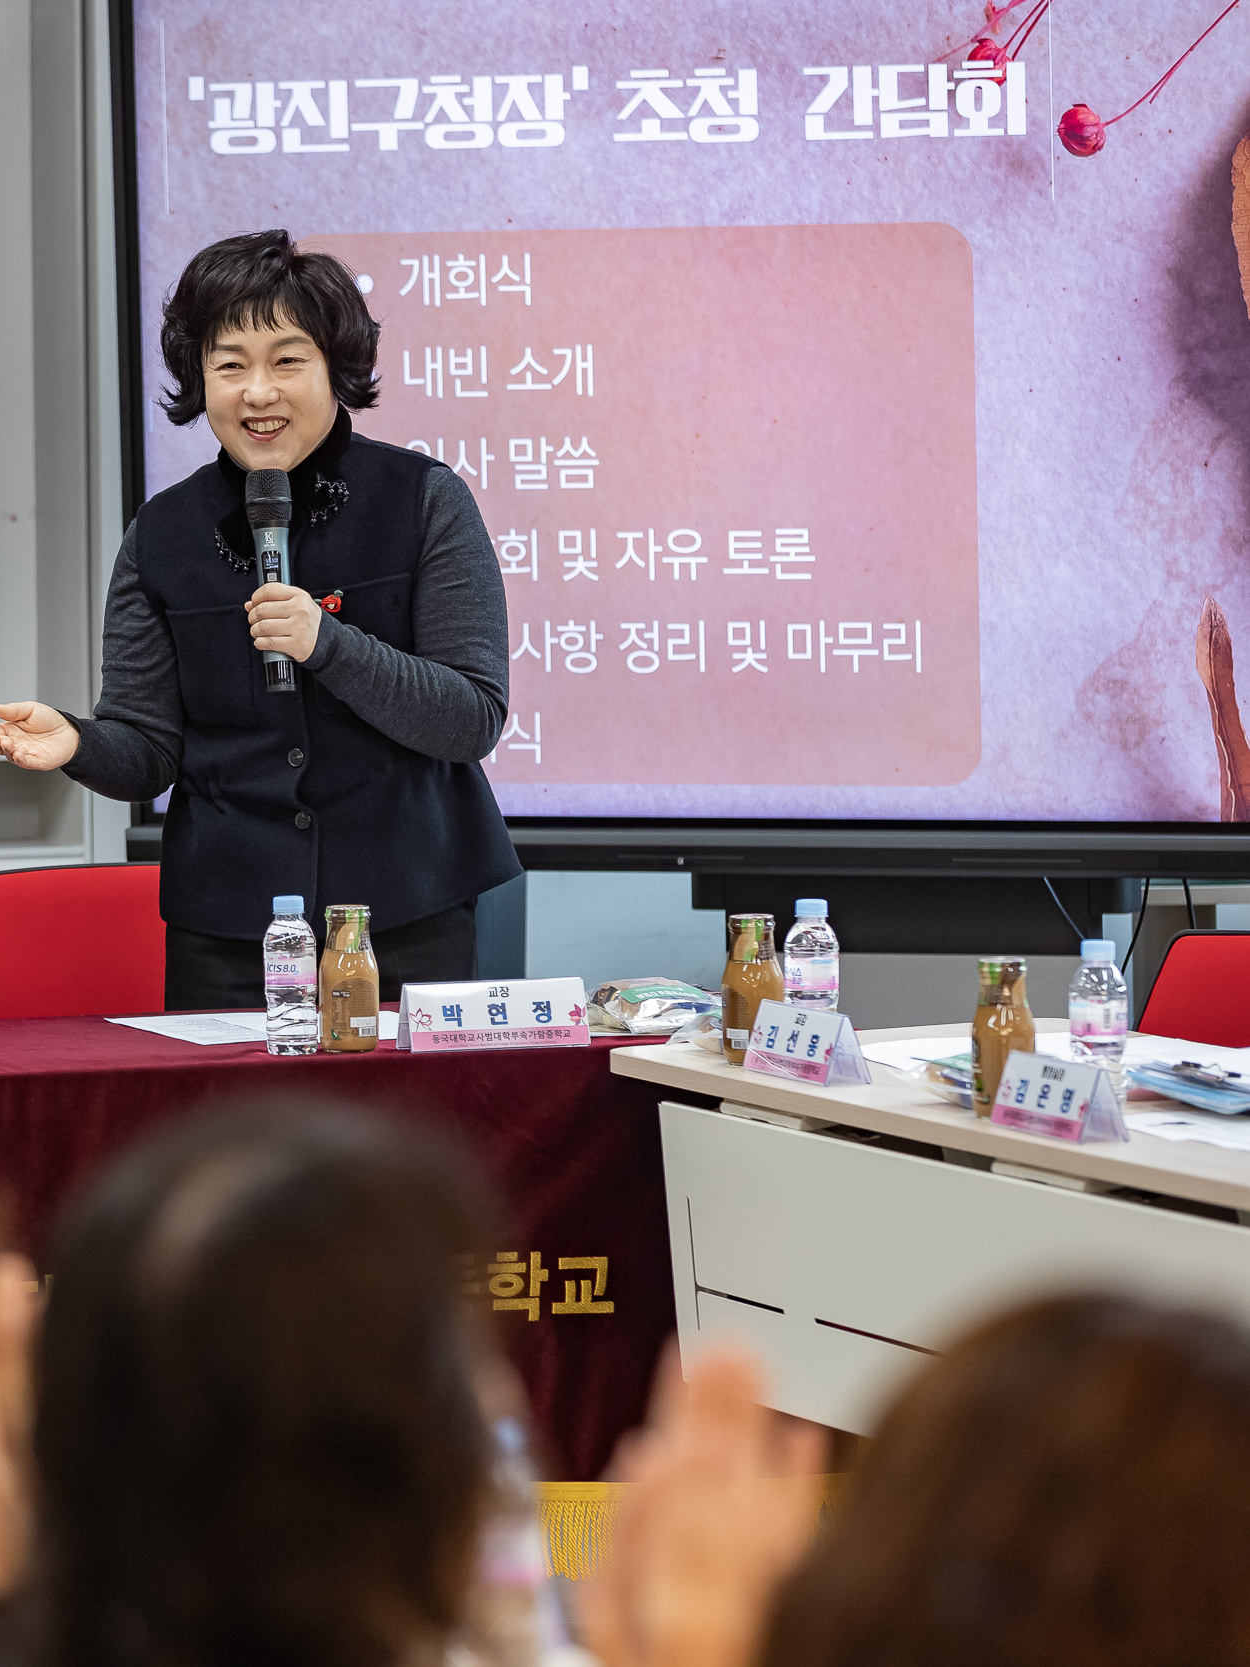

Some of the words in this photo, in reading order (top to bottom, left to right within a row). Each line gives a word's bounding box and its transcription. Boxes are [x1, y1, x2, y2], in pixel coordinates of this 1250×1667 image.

[188, 65, 590, 156] '광진구청장'
[611, 67, 761, 145] 초청
[801, 60, 1028, 142] 간담회
[399, 252, 533, 307] 개회식
[402, 345, 489, 399] 내빈
[505, 343, 595, 398] 소개
[508, 436, 600, 490] 말씀
[491, 528, 539, 582] 회
[557, 528, 600, 582] 및
[614, 527, 710, 581] 자유
[721, 528, 817, 581] 토론
[618, 619, 707, 674] 정리
[726, 619, 770, 674] 및
[786, 619, 923, 674] 마무리
[490, 711, 542, 765] 식
[488, 986, 510, 998] 교장
